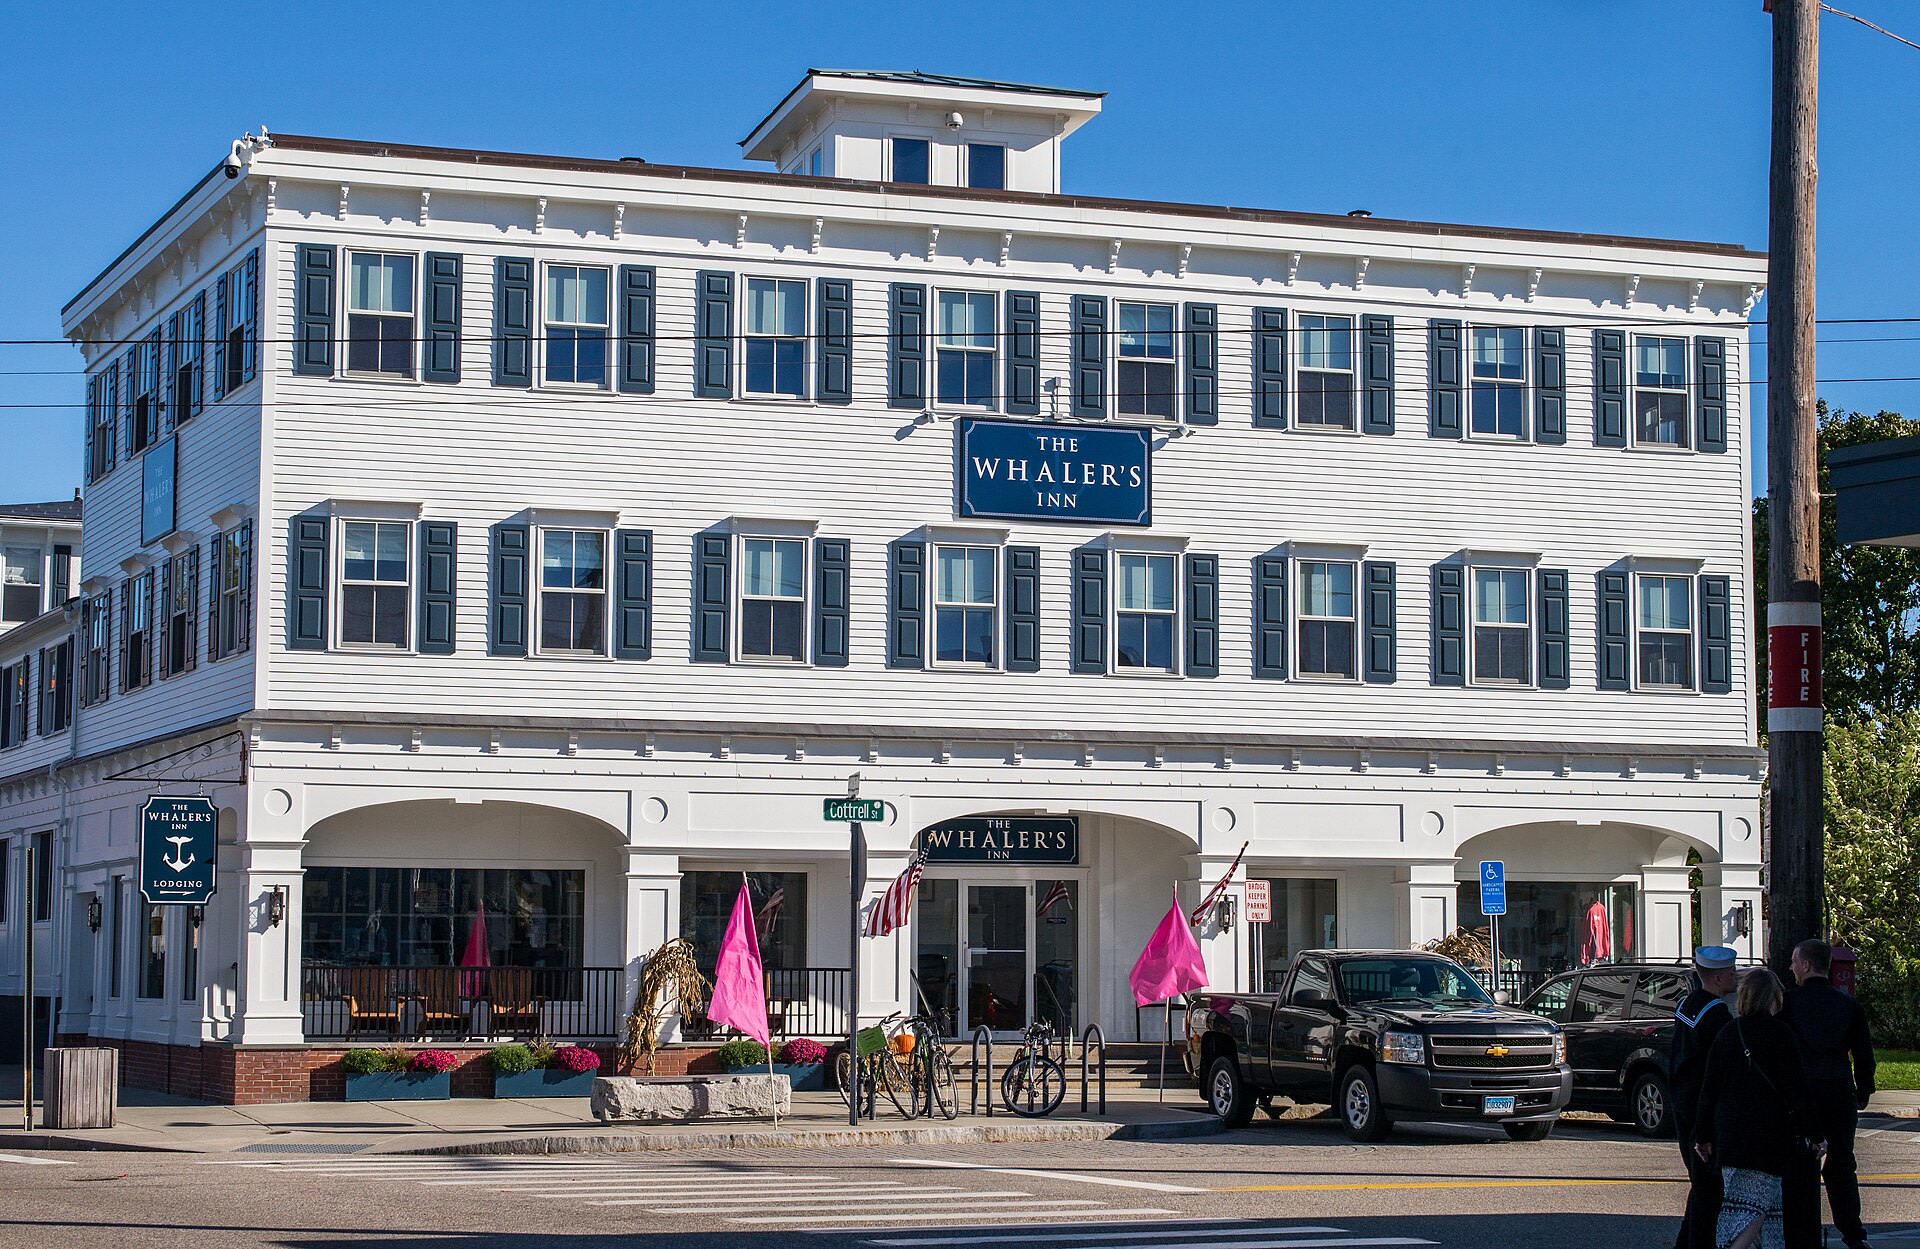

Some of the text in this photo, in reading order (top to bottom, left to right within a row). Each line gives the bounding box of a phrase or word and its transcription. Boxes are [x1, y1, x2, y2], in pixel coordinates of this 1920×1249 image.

[1036, 436, 1079, 453] THE
[972, 457, 1142, 488] WHALER'S
[1037, 492, 1077, 509] INN
[1800, 632, 1810, 702] FIRE
[148, 811, 211, 822] WHALER'S
[830, 802, 878, 819] Cottrell St
[987, 820, 1011, 829] THE
[930, 830, 1067, 849] WHALER'S
[987, 850, 1010, 860] INN
[153, 880, 203, 888] LODGING
[1248, 882, 1266, 890] BRIDGE
[1248, 892, 1267, 900] KEEPER
